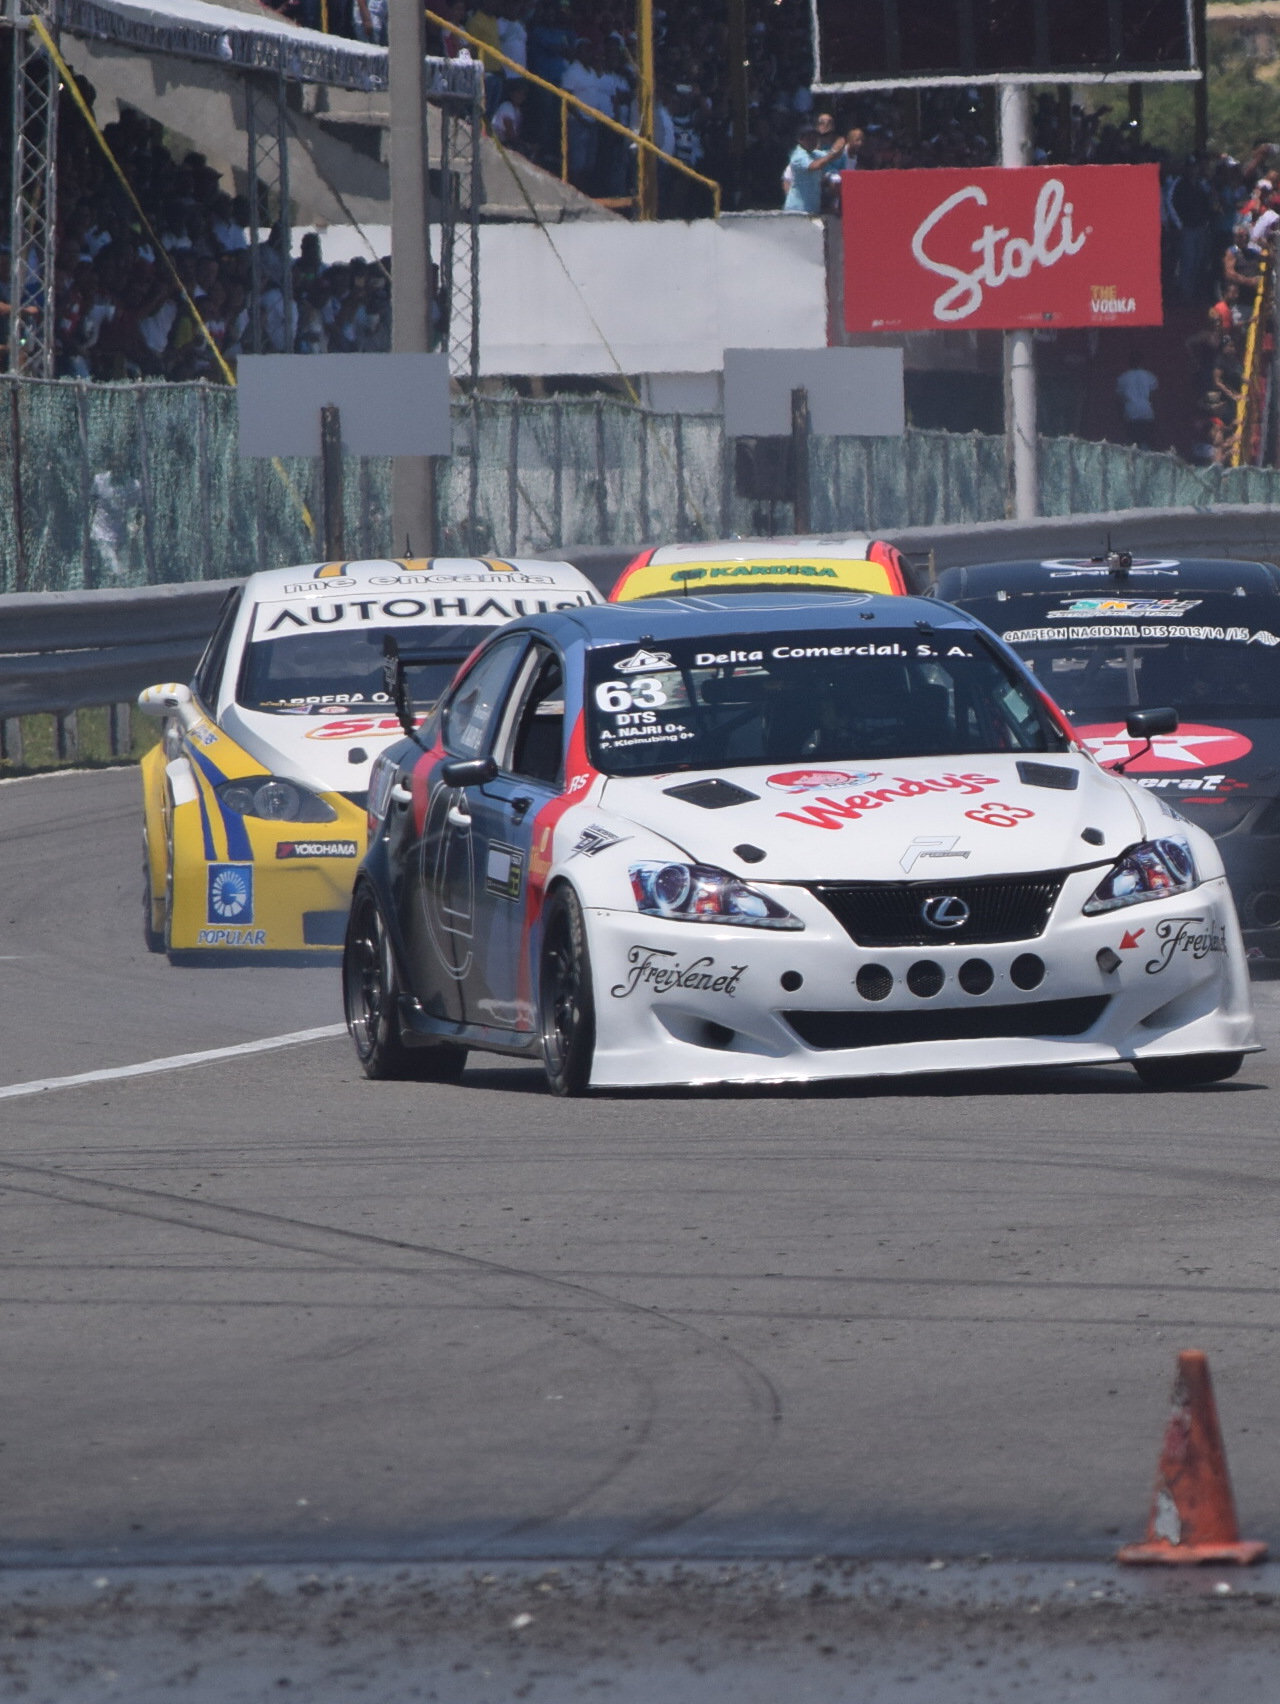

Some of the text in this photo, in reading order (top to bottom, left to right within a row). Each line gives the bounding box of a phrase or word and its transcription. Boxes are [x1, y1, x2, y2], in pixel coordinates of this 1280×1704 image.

[912, 178, 1087, 322] Stoli
[1090, 285, 1116, 300] THE
[710, 565, 838, 578] KARDISA
[284, 572, 556, 594] me encanta
[1003, 627, 1067, 643] CAMPEON
[1069, 625, 1140, 640] NACIONAL
[1142, 625, 1168, 638] DTS
[695, 643, 973, 666] Delta Comercial, S. A.
[595, 678, 667, 713] 63
[616, 711, 657, 725] DTS
[600, 730, 616, 740] A.
[618, 726, 662, 738] NAJRI
[600, 742, 612, 750] P.
[614, 734, 678, 748] Kleinubing
[775, 772, 1001, 830] Wendy's
[964, 802, 1036, 828] 63
[295, 843, 356, 856] YOKOHAMA
[197, 929, 267, 945] POPULAR
[610, 944, 749, 998] Freixenet
